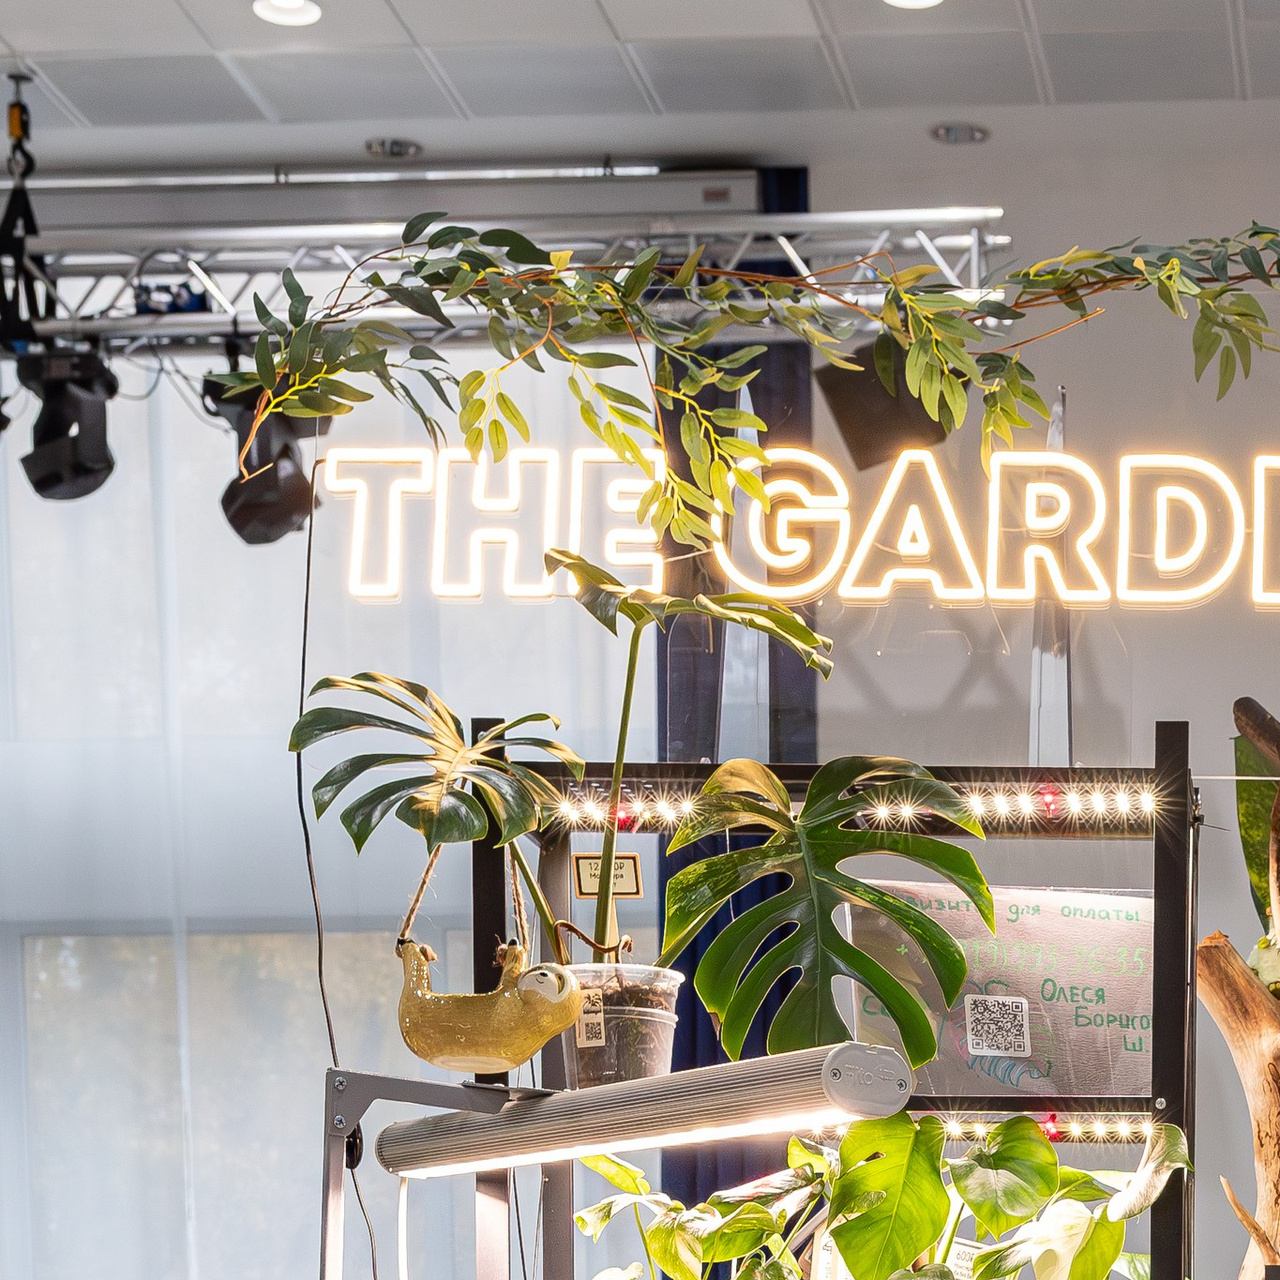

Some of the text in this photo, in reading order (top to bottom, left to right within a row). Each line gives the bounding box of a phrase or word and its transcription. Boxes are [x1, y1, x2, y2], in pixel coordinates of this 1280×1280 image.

[326, 446, 666, 600] THE
[1008, 904, 1140, 922] для оплаты
[1041, 978, 1106, 1004] ОЛЕСЯ
